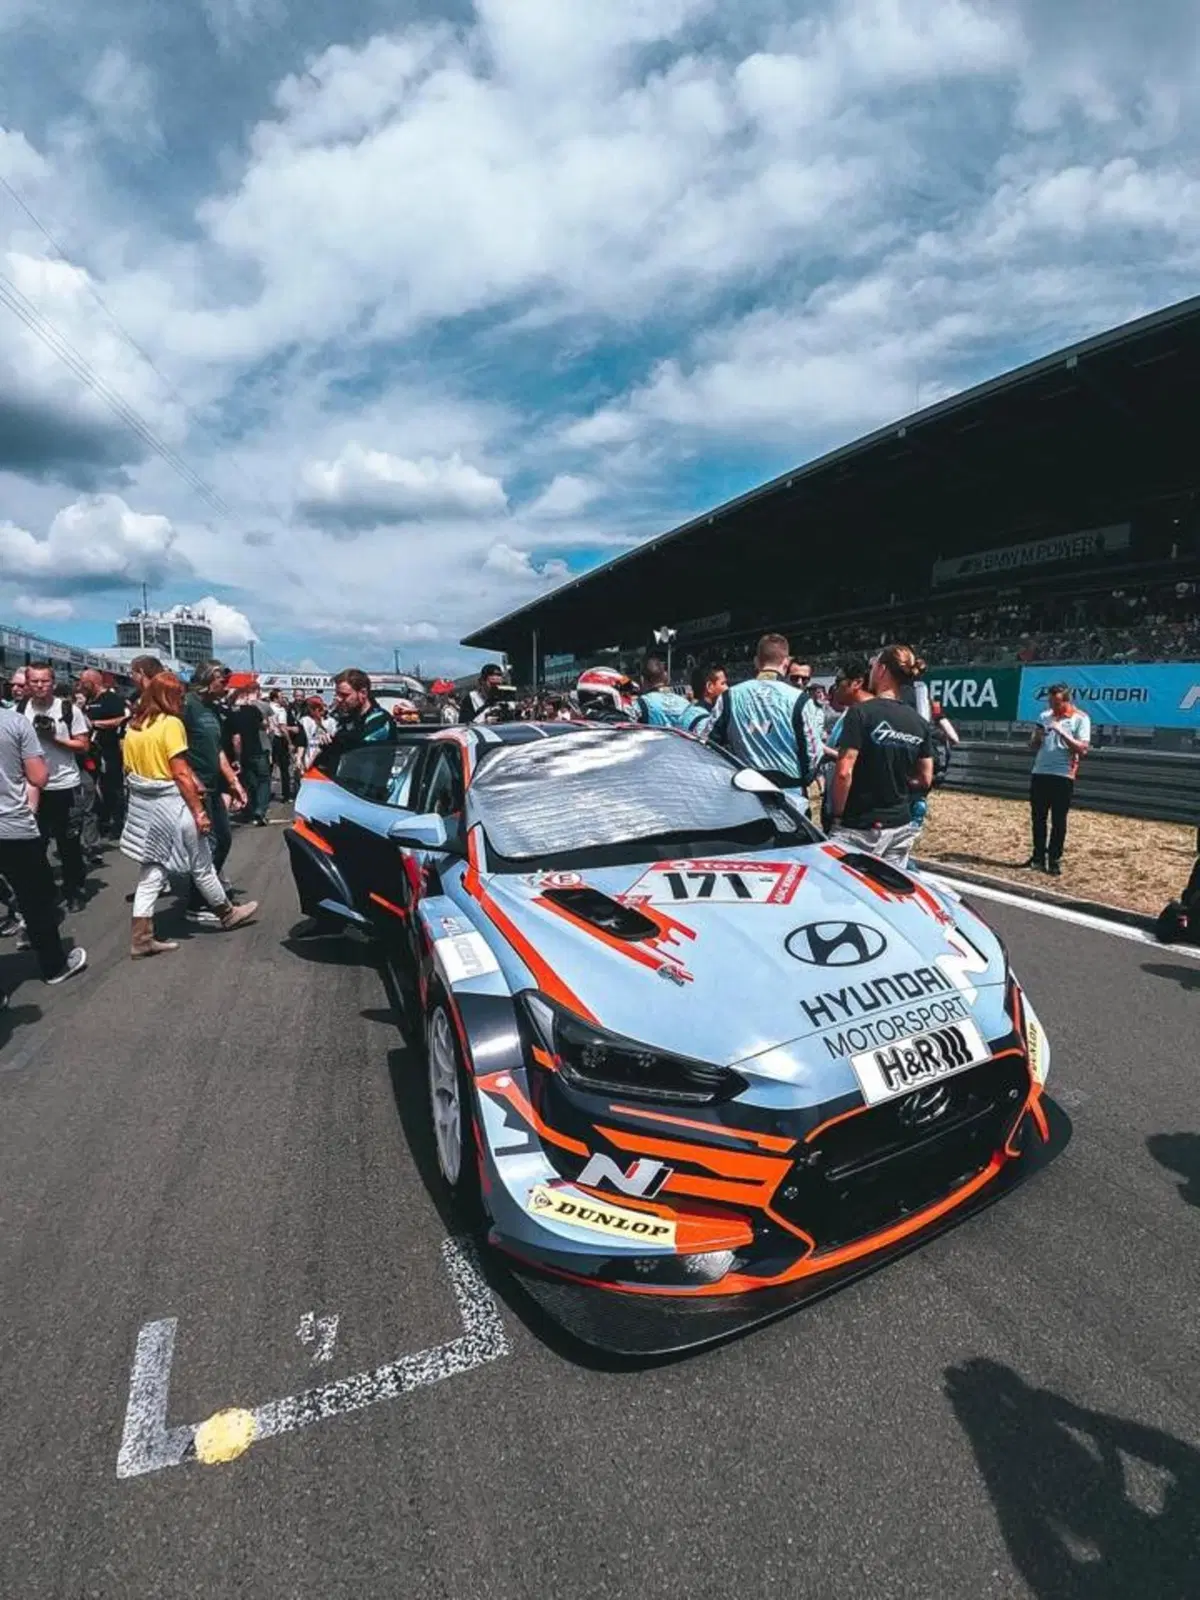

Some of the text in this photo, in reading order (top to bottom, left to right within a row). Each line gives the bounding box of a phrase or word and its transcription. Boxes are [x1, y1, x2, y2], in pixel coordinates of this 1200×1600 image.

[1036, 535, 1093, 561] POWER
[291, 676, 321, 687] BMW
[698, 862, 773, 872] TOTAL
[662, 872, 754, 900] 171
[799, 966, 954, 1027] HYUNDAI
[822, 996, 971, 1060] MOTORSPORT
[874, 1035, 946, 1090] H&R
[554, 1200, 671, 1237] DUNLOP
